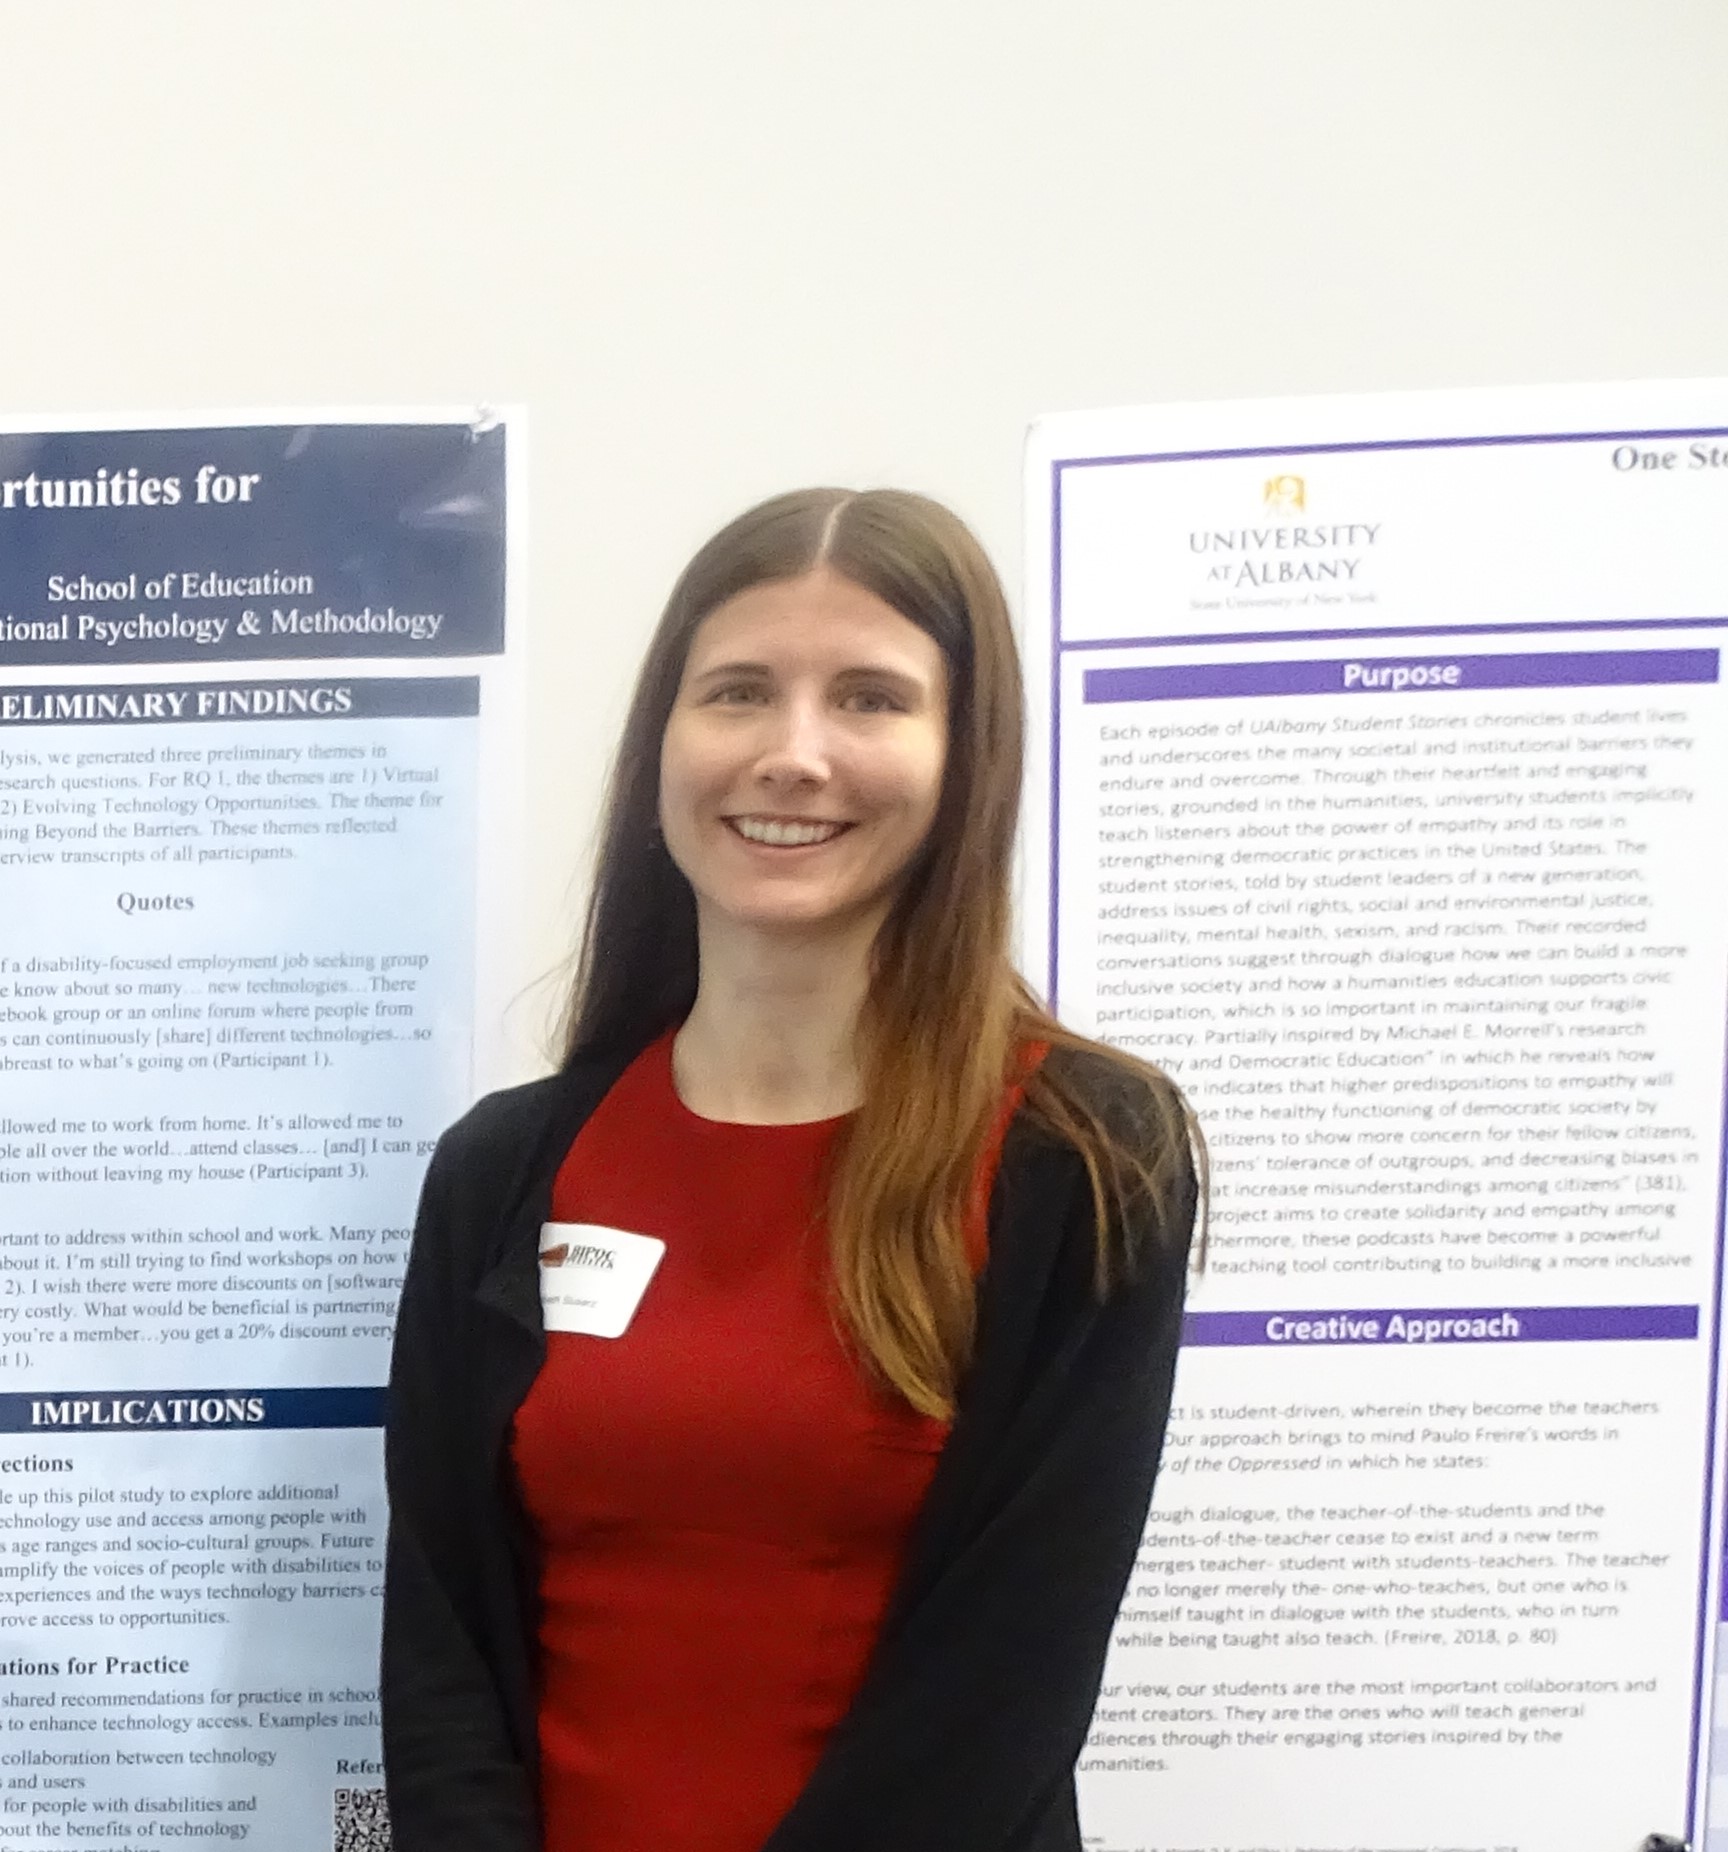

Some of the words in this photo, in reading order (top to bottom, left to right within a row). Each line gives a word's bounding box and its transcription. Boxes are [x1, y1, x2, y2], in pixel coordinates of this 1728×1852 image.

[1612, 445, 1678, 471] One
[195, 464, 261, 505] for
[1189, 523, 1381, 554] UNIVERSITY
[48, 573, 136, 602] School
[144, 571, 177, 600] of
[182, 568, 313, 599] Education
[1207, 564, 1233, 582] AT
[1234, 558, 1360, 588] ALBANY
[78, 611, 229, 647] Psychology
[236, 609, 261, 636] &
[271, 606, 444, 640] Methodology
[1343, 664, 1461, 689] Purpose
[198, 687, 352, 717] FINDINGS
[116, 891, 195, 916] Quotes
[1266, 1315, 1379, 1342] Creative
[1386, 1313, 1520, 1343] Approach
[31, 1397, 265, 1426] IMPLICATIONS
[1115, 1631, 1164, 1649] while
[1168, 1630, 1218, 1651] being
[1222, 1630, 1280, 1651] taught
[1285, 1630, 1321, 1647] also
[1325, 1629, 1378, 1646] teach.
[1384, 1628, 1447, 1647] (Freire,
[1453, 1627, 1501, 1646] 2018,
[1529, 1627, 1557, 1646] 80)
[67, 1656, 98, 1676] for
[106, 1655, 190, 1675] Practice
